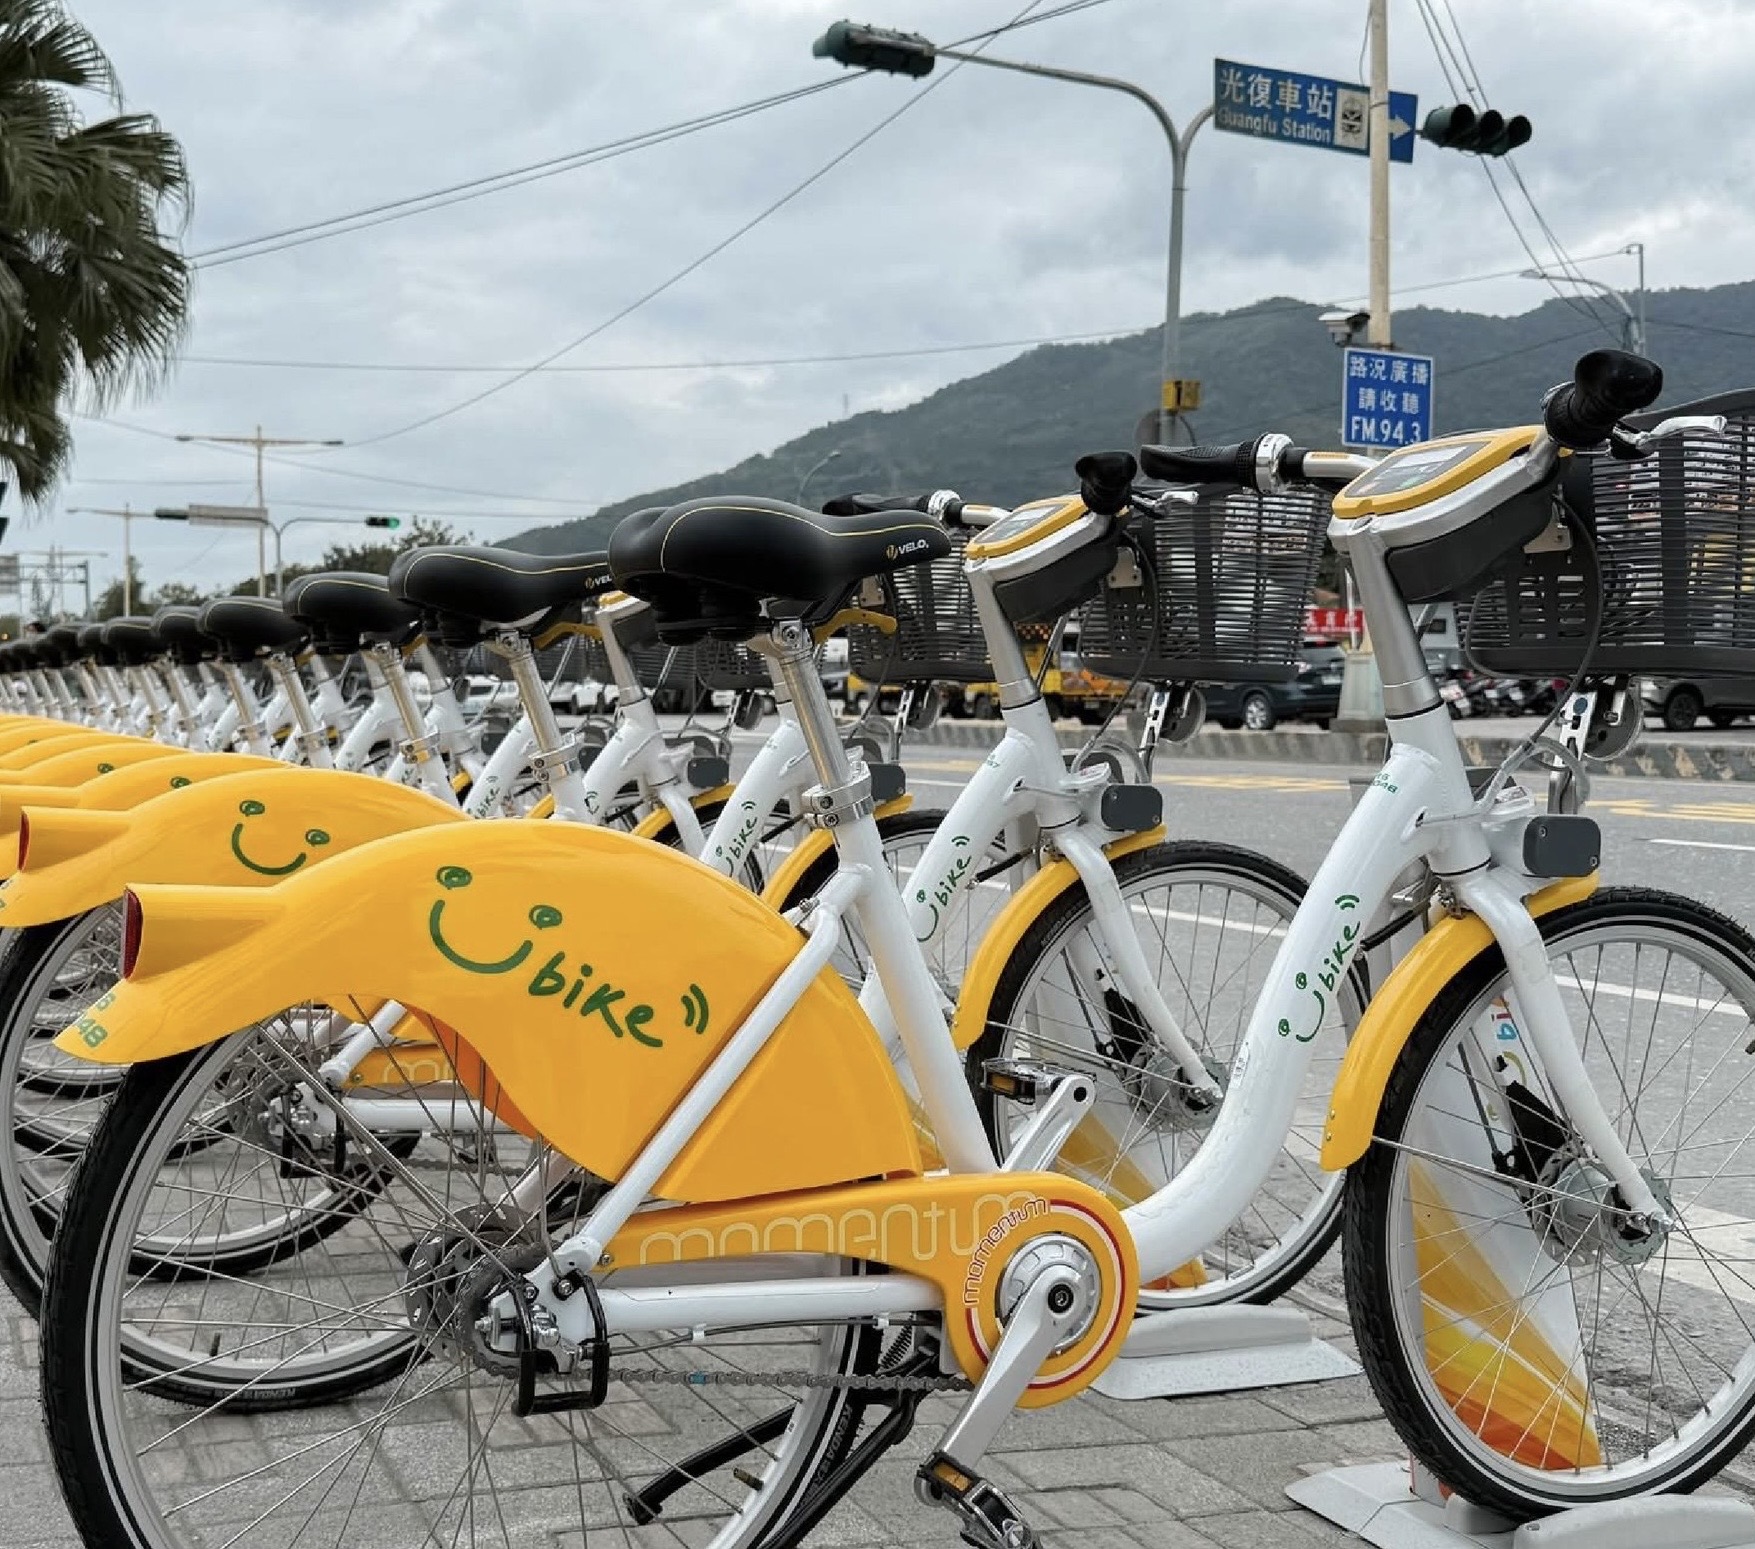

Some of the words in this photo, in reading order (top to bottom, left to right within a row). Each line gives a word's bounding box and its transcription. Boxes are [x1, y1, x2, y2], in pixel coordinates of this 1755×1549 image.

[1219, 68, 1334, 120] 光復車站
[1217, 106, 1277, 136] Guangfu
[1281, 118, 1331, 143] Station
[1349, 355, 1429, 386] 路況廣播
[1358, 387, 1420, 415] 請收聽
[594, 574, 613, 587] VEL
[639, 1191, 1038, 1266] momentum
[963, 1196, 1049, 1306] momentum
